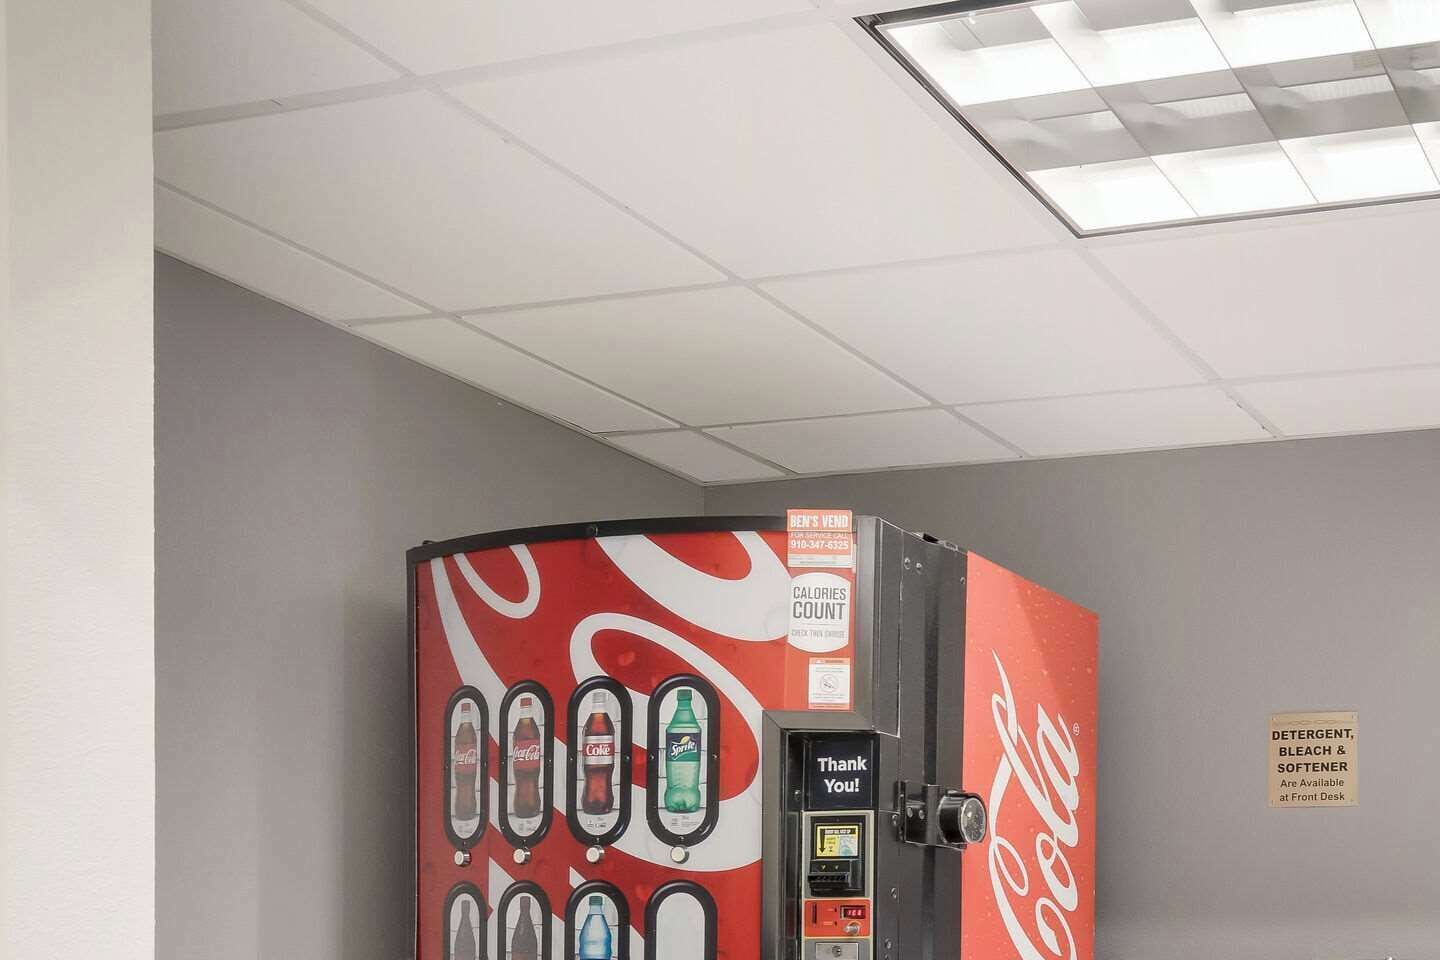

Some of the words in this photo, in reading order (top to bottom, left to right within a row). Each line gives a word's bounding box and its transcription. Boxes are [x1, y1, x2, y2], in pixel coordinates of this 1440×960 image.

[791, 514, 818, 528] BEN'S
[822, 514, 849, 528] VEND
[793, 586, 847, 600] CALORIES
[793, 601, 846, 620] COUNT
[1272, 728, 1354, 740] DETERGENT,
[586, 744, 610, 756] Coke
[671, 741, 696, 757] Sprite
[1280, 745, 1332, 756] BLEACH
[1337, 745, 1346, 755] &
[816, 756, 867, 772] Thank
[1277, 762, 1348, 773] SOFTENER
[824, 778, 859, 793] You!
[1280, 779, 1297, 787] Are
[1300, 778, 1345, 787] Available
[1280, 793, 1288, 801] at
[1291, 792, 1317, 801] Front
[1320, 791, 1345, 800] Desk
